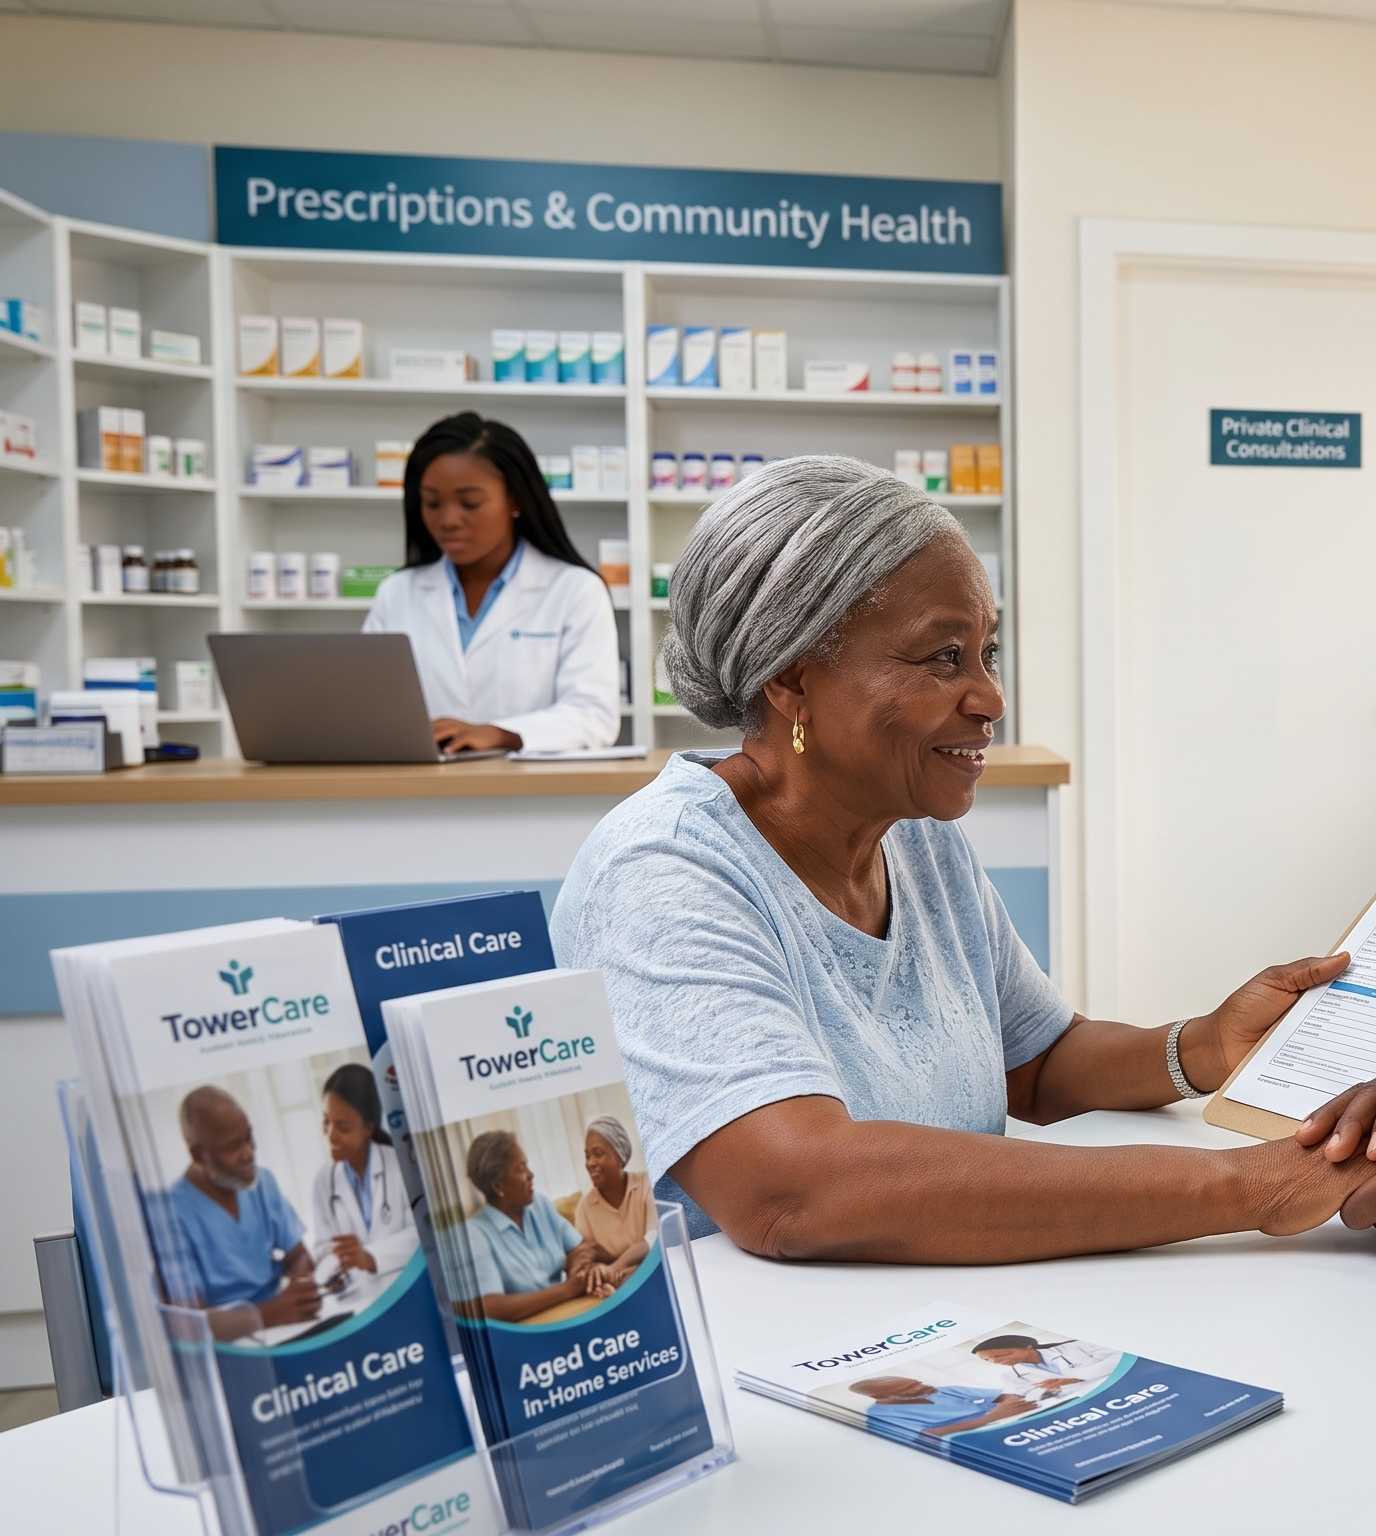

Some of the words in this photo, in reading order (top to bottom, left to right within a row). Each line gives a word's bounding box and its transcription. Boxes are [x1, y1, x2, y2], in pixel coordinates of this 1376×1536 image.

[247, 176, 533, 233] Prescriptions
[544, 190, 576, 231] &
[586, 191, 830, 249] Community
[841, 203, 972, 246] Health
[1222, 416, 1284, 437] Private
[1286, 418, 1350, 439] Clinical
[1226, 439, 1347, 461] Consultations
[375, 932, 464, 971] Clinical
[469, 930, 523, 956] Care
[161, 993, 331, 1043] TowerCare
[459, 1035, 596, 1082] TowerCare
[519, 1343, 584, 1391] Aged
[587, 1328, 641, 1362] Care
[606, 1344, 680, 1386] Services
[792, 1318, 958, 1372] TowerCare
[252, 1360, 359, 1424] Clinical
[361, 1341, 425, 1382] Care
[1003, 1406, 1110, 1448] Clinical
[1104, 1381, 1171, 1411] Care
